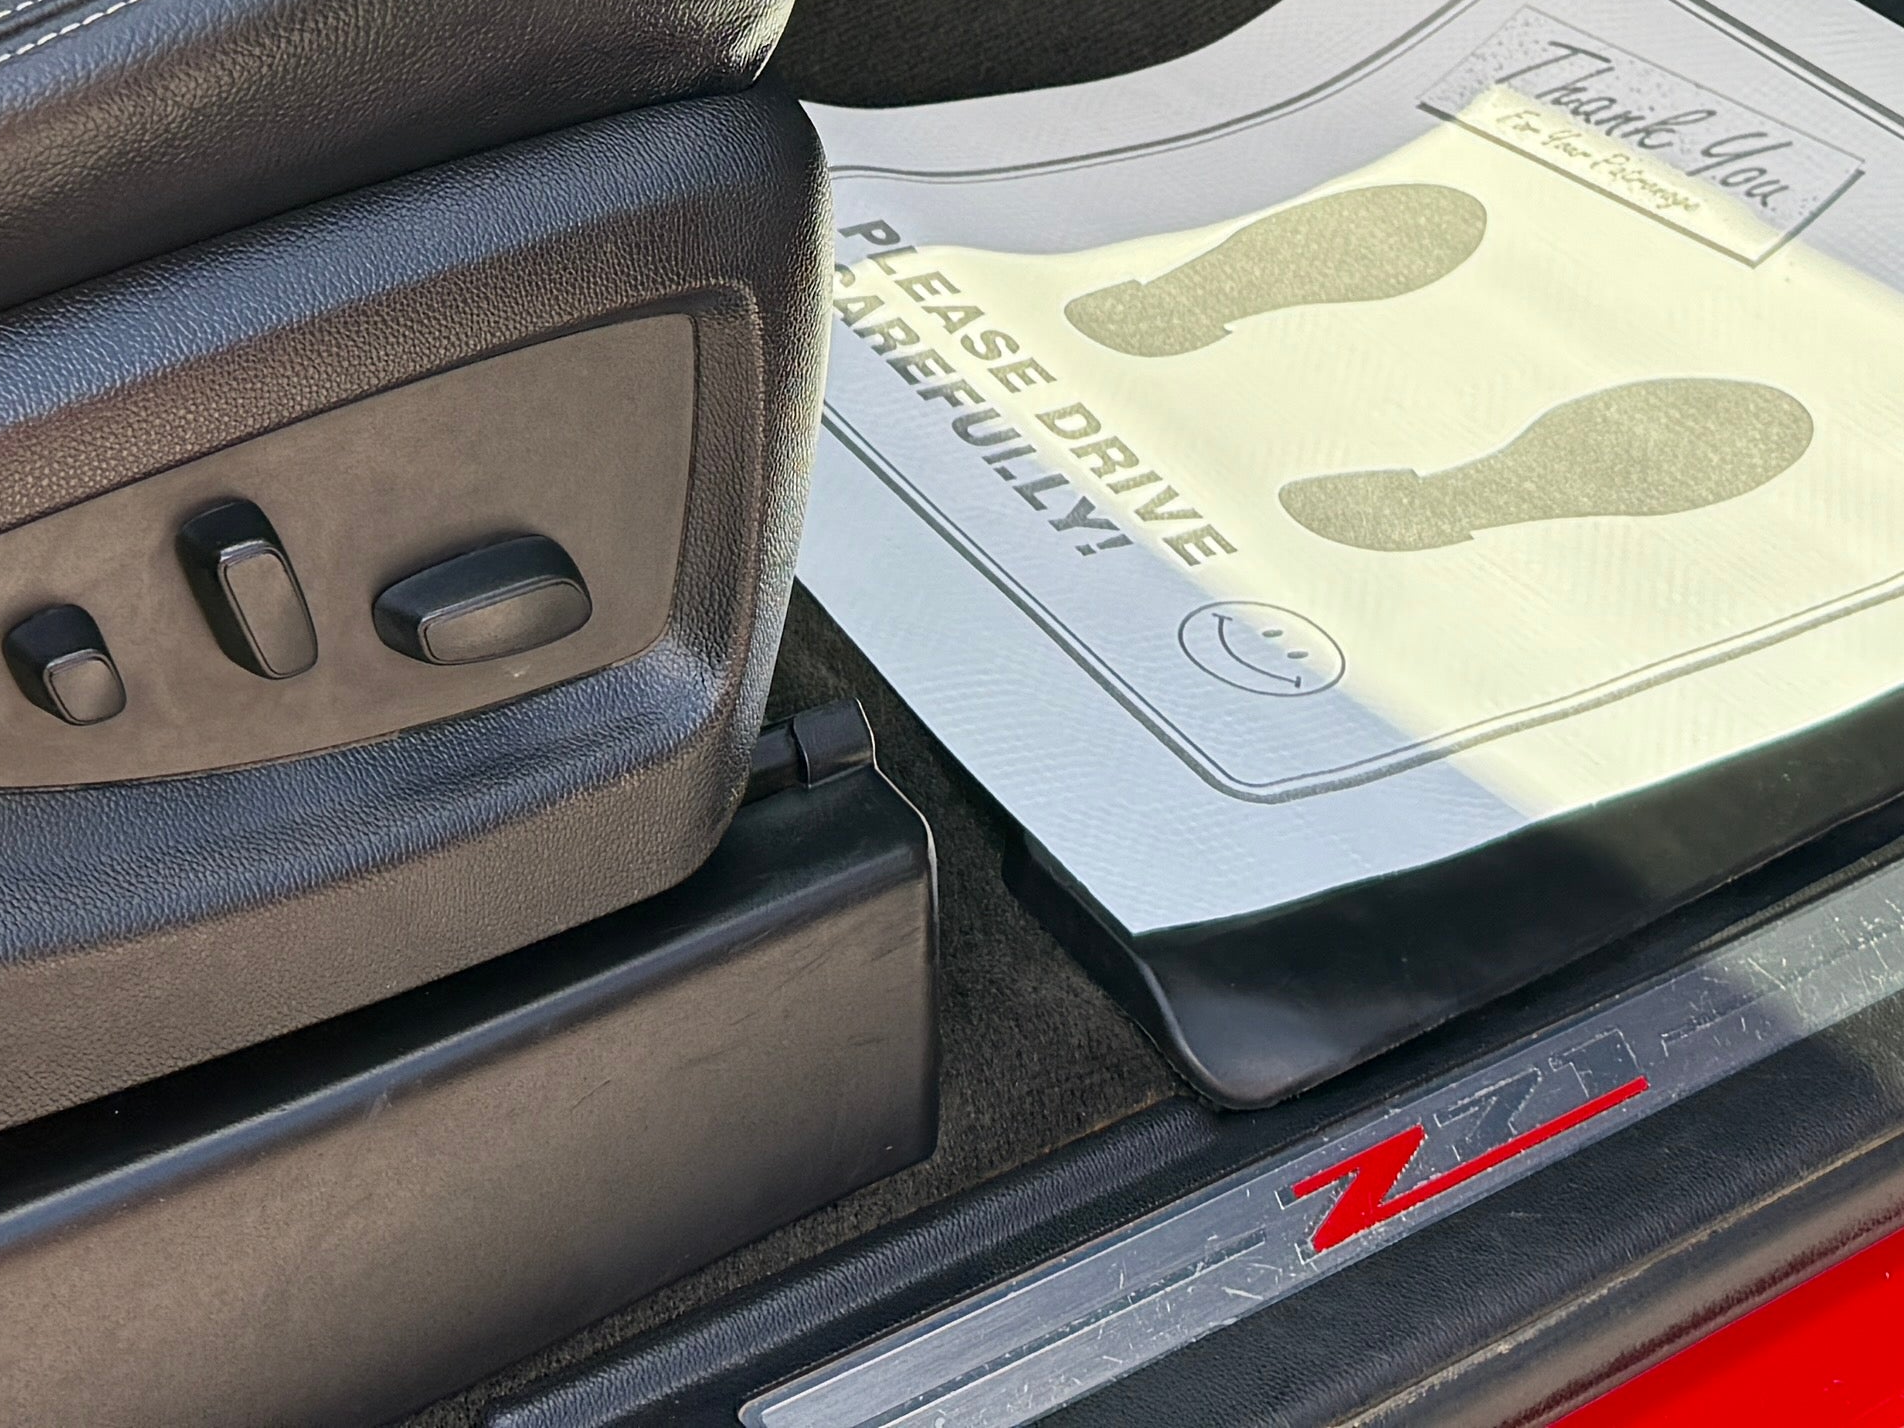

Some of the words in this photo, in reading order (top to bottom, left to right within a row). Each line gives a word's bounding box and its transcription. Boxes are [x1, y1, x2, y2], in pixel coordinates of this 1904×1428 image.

[1495, 40, 1718, 150] Thank
[1685, 131, 1793, 209] You
[837, 218, 1057, 394] PLEASE
[1035, 401, 1239, 568] DRIVE
[1274, 1027, 1650, 1265] Z71
